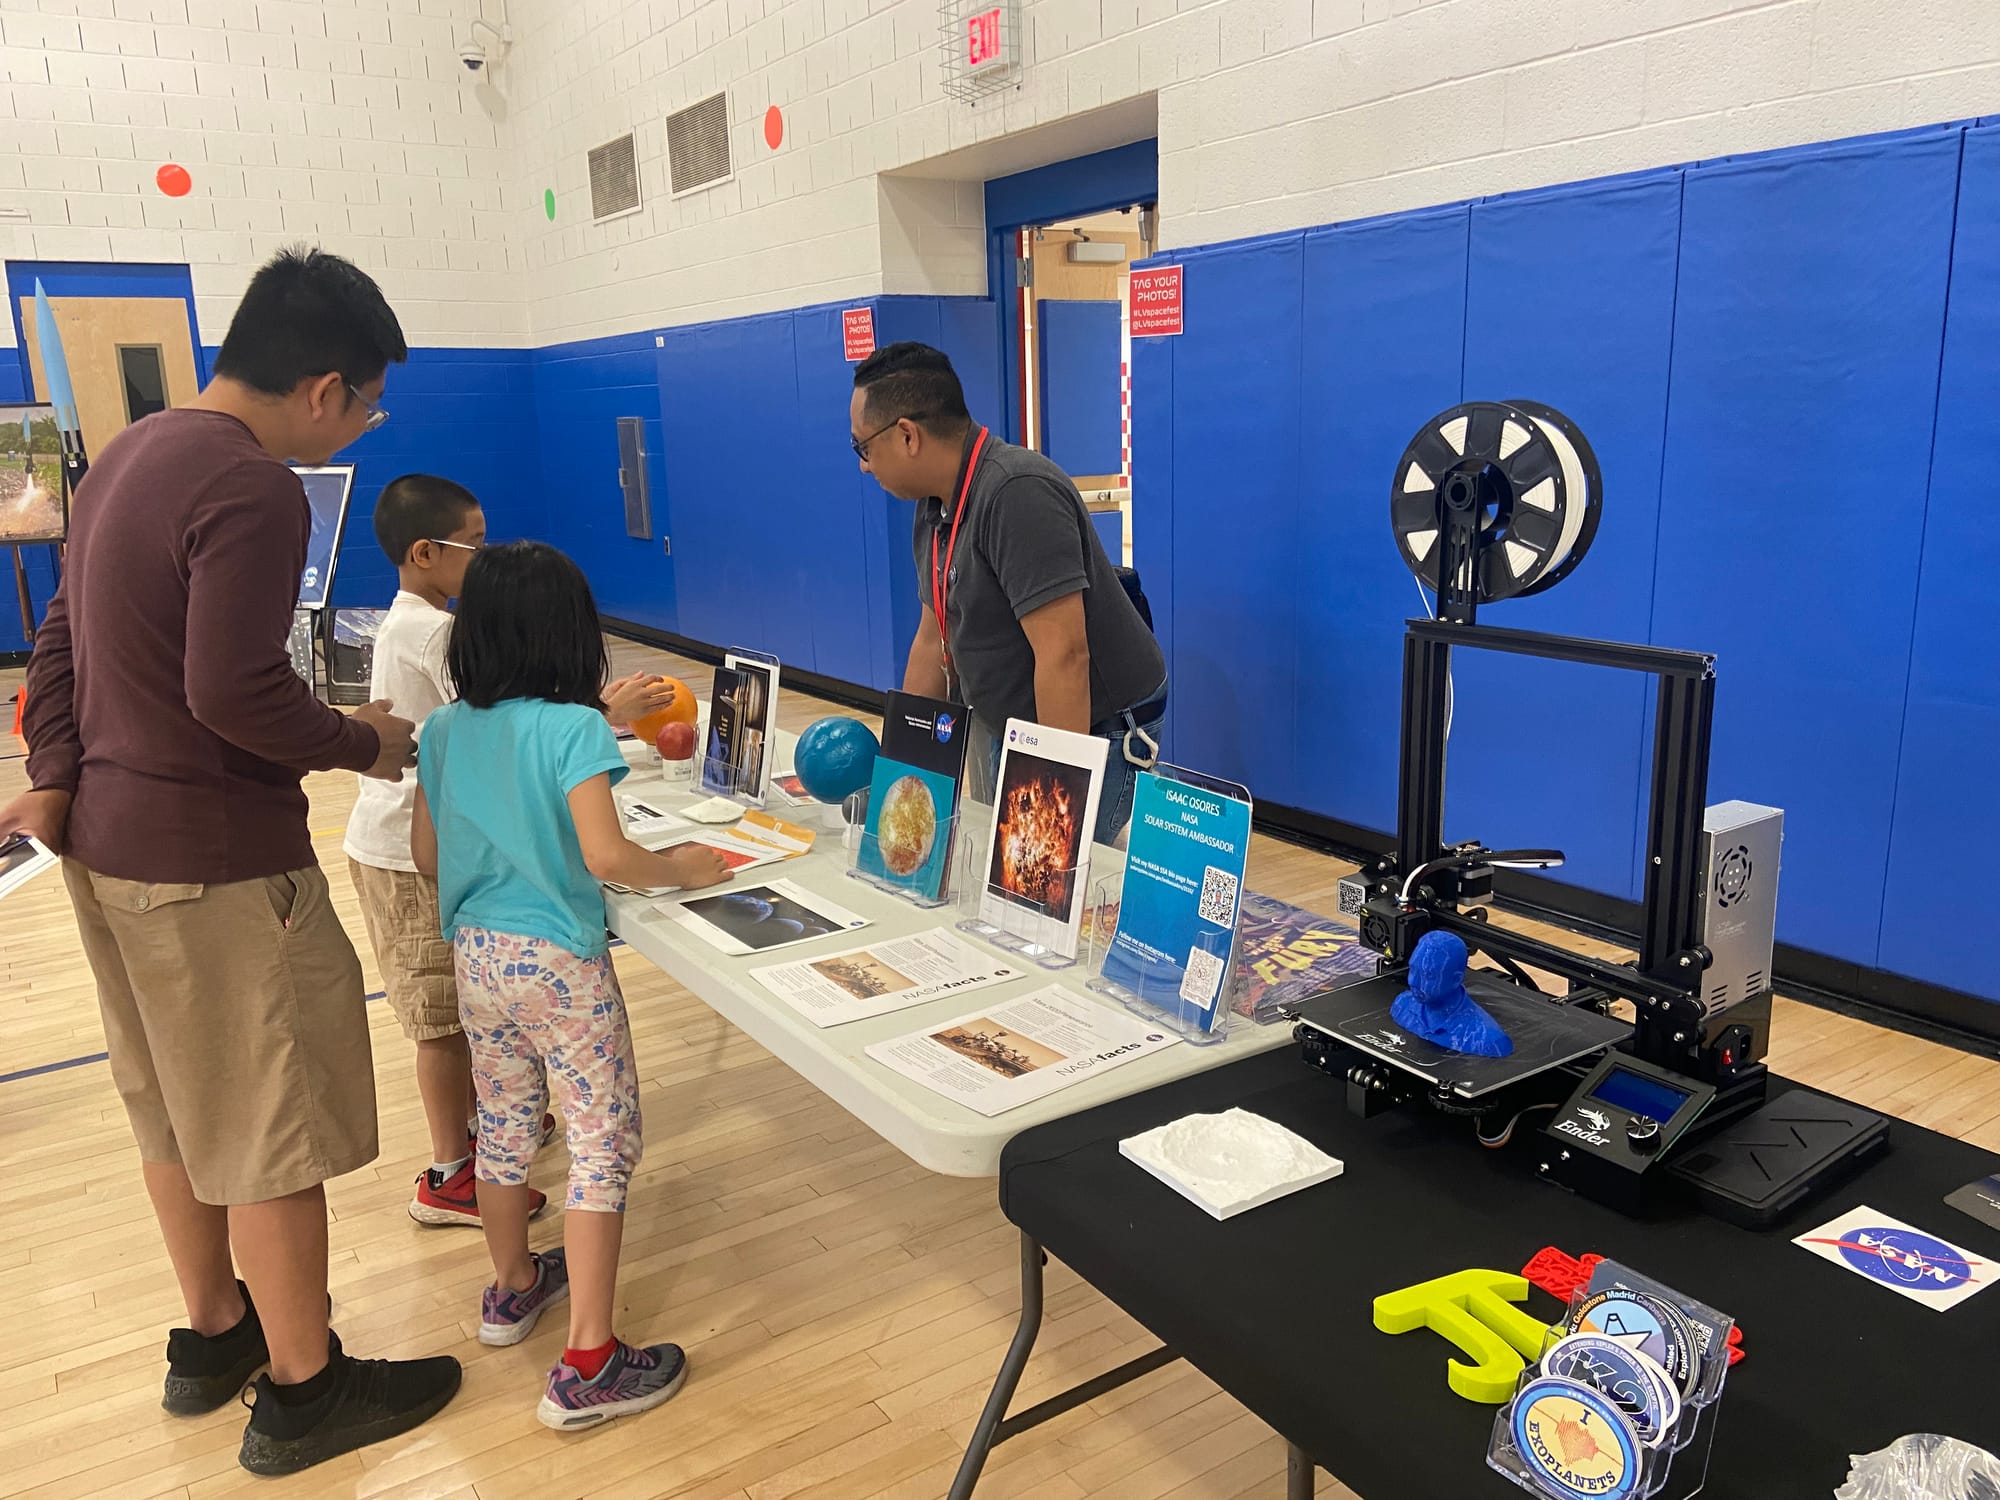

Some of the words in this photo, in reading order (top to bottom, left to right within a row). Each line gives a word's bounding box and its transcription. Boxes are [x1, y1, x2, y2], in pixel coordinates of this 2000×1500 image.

[969, 9, 1001, 64] EXIT
[1132, 278, 1152, 290] TAG
[1153, 275, 1178, 288] YOUR
[1137, 288, 1177, 302] PHOTOS!
[1132, 316, 1180, 330] @LVspacefest
[1025, 735, 1039, 746] esa
[1165, 789, 1189, 806] ISAAC
[1188, 797, 1220, 817] OSORES
[1180, 811, 1199, 826] NASA
[1143, 813, 1164, 829] SOLAR
[1164, 821, 1188, 838] SYSTEM
[1188, 830, 1235, 854] AMBASSADOR
[1252, 930, 1359, 985] FURY
[901, 975, 988, 1000] NASAfacts
[1354, 1033, 1403, 1053] Ender
[1055, 1042, 1142, 1077] NASAfacts
[1553, 1119, 1611, 1146] Ender
[1857, 1232, 1959, 1284] NASA
[1572, 1293, 1606, 1325] Goldstone
[1606, 1290, 1636, 1301] Madrid
[1635, 1293, 1667, 1327] Canberra
[1665, 1344, 1676, 1376] nabled
[1673, 1325, 1688, 1381] Exploration
[1580, 1409, 1592, 1426] I
[1529, 1420, 1616, 1490] EXOPLANETS
